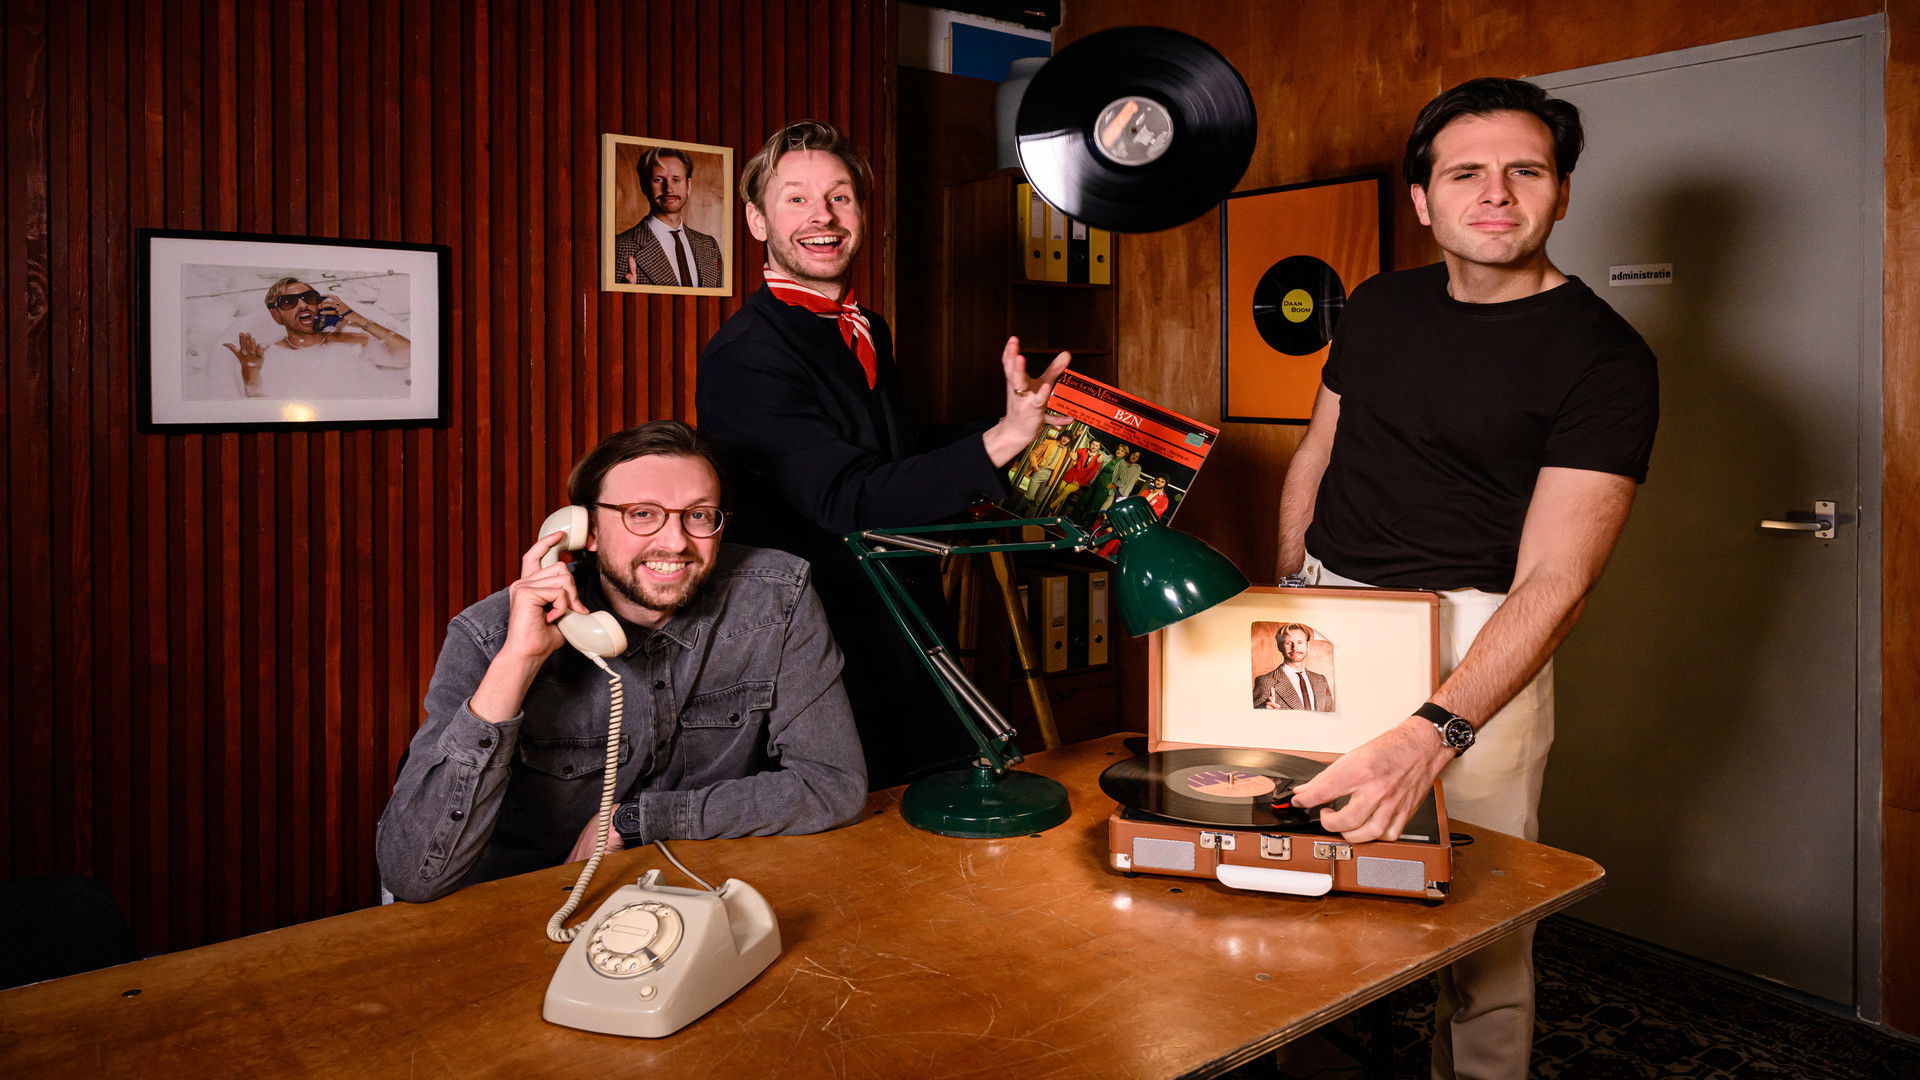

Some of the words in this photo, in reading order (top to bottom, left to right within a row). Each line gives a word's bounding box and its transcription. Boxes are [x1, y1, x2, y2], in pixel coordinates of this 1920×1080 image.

[1611, 269, 1671, 280] administratie
[1058, 373, 1078, 387] Music
[1113, 408, 1143, 428] BZN
